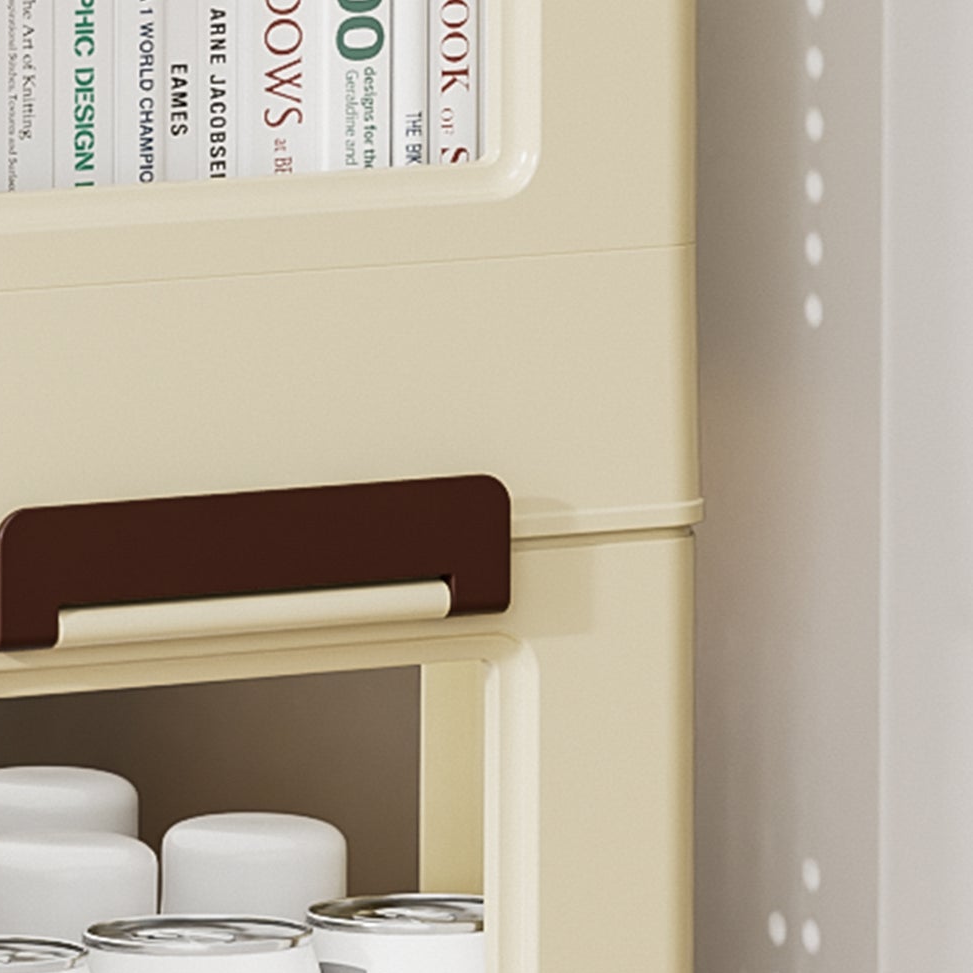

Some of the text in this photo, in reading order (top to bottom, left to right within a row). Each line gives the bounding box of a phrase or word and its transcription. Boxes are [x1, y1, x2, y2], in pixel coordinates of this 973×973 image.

[22, 24, 35, 50] Art
[22, 53, 37, 71] of
[139, 22, 155, 92] WORLD
[209, 8, 227, 65] ARNE
[18, 74, 37, 141] Knitting
[74, 67, 95, 171] DESIGN
[170, 63, 189, 137] EAMES
[345, 69, 360, 166] Geraldine and
[360, 66, 378, 122] designs
[363, 124, 378, 146] for
[405, 111, 423, 137] THE
